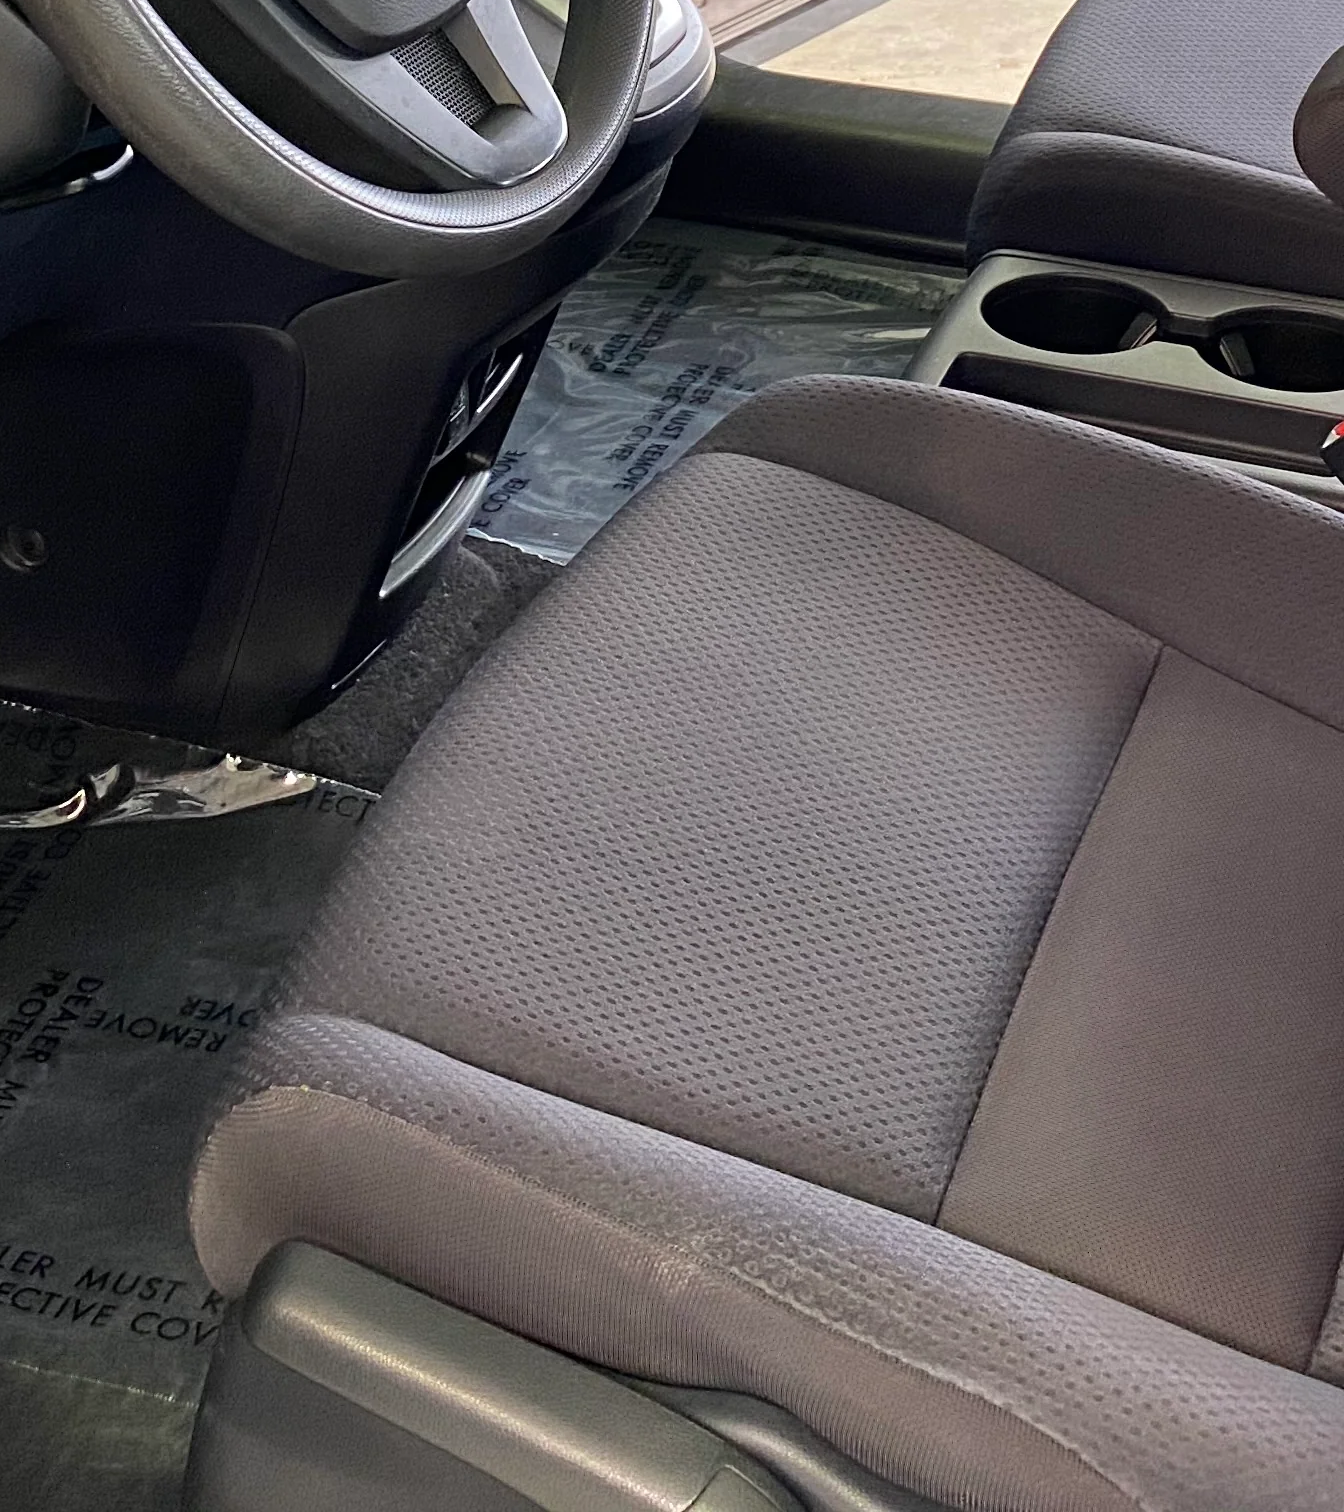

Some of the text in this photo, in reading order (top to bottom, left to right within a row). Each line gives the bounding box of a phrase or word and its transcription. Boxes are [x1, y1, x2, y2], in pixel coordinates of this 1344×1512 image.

[660, 406, 699, 441] MUST
[606, 424, 654, 463] COVER
[613, 442, 669, 491] REMOVE
[482, 477, 532, 514] COVER
[21, 975, 105, 1065] DEALER
[85, 1008, 229, 1054] REMOVE
[75, 1267, 190, 1305] MUST
[130, 1311, 221, 1346] COV
